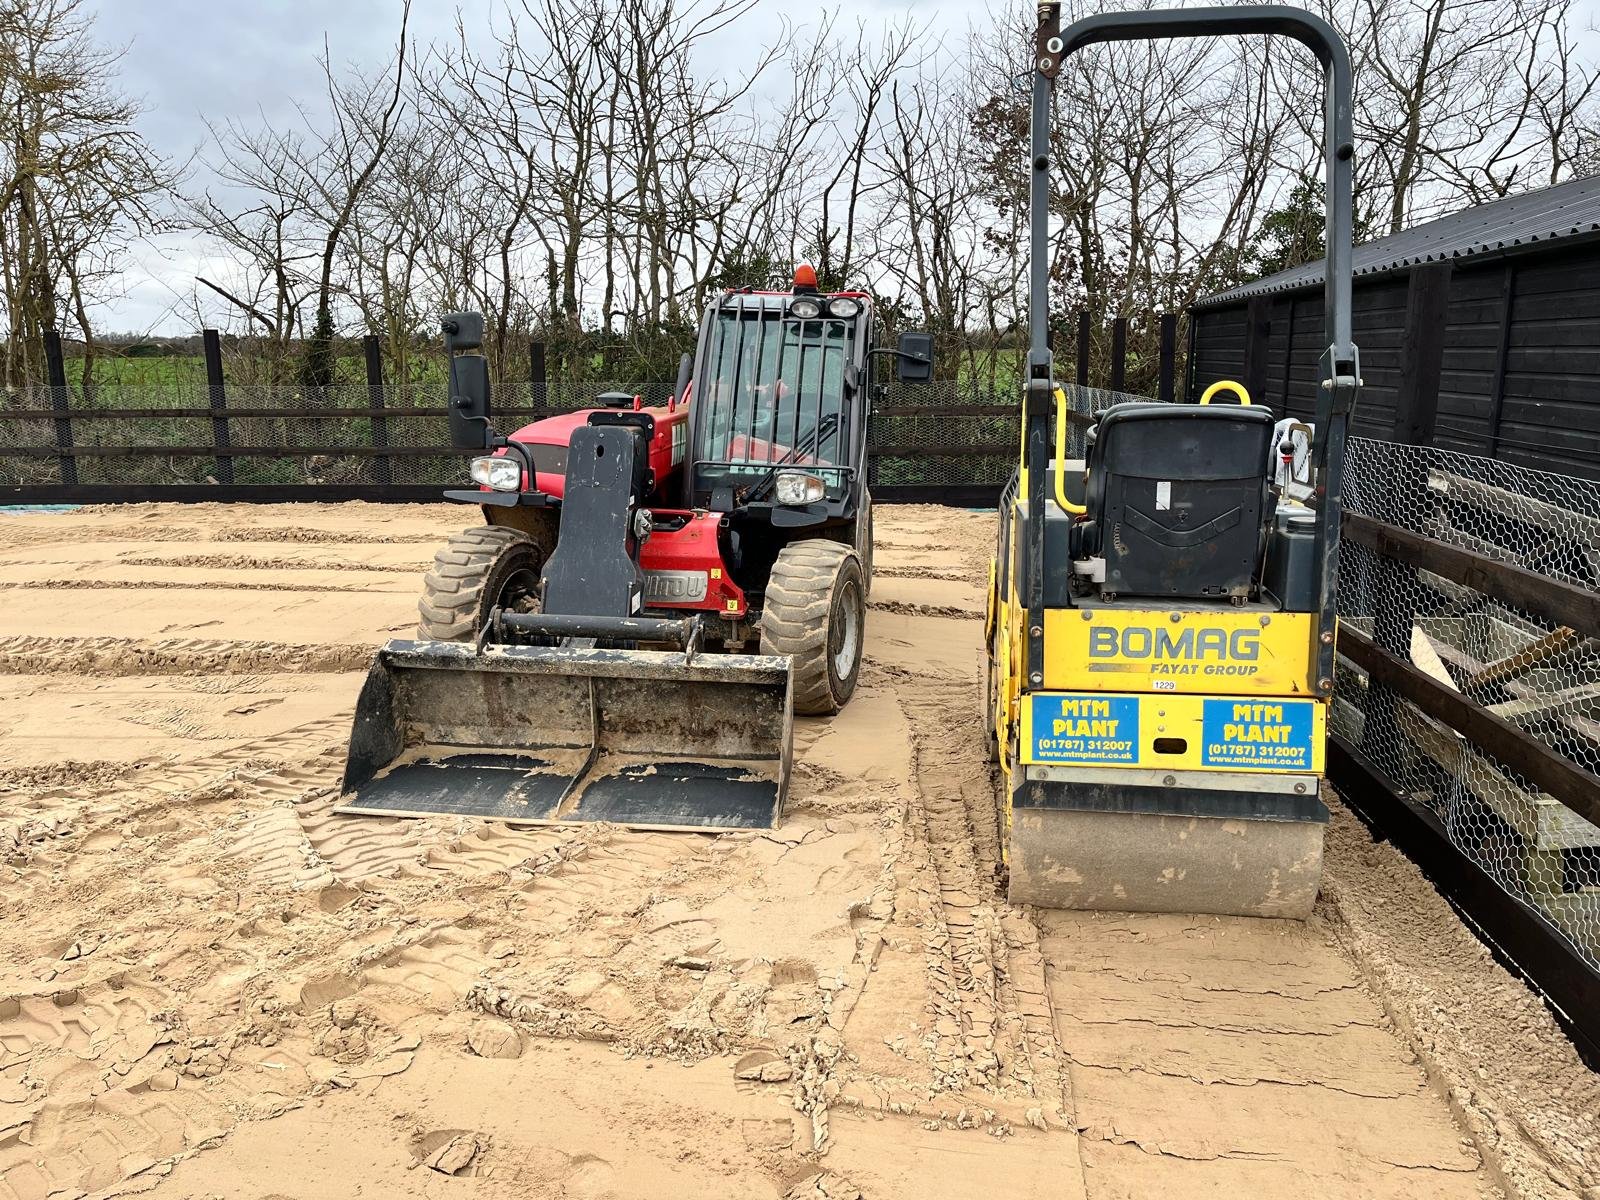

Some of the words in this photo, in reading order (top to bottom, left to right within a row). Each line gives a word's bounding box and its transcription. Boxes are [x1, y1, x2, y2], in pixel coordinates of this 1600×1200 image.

[1089, 626, 1260, 660] BOMAG
[1150, 663, 1199, 675] FAYAT
[1204, 665, 1258, 676] GROUP
[1155, 681, 1175, 690] 1229
[1061, 699, 1110, 717] MTM
[1233, 704, 1283, 723] MTM
[1052, 719, 1119, 737] PLANT
[1223, 724, 1292, 743] PLANT
[1039, 739, 1085, 751] (01787)
[1087, 740, 1133, 751] 312007
[1208, 744, 1256, 757] (01787)
[1259, 746, 1306, 757] 312007
[1039, 751, 1133, 760] www.mtmplant.co.uk
[1208, 756, 1305, 766] www.mtmplant.co.uk
